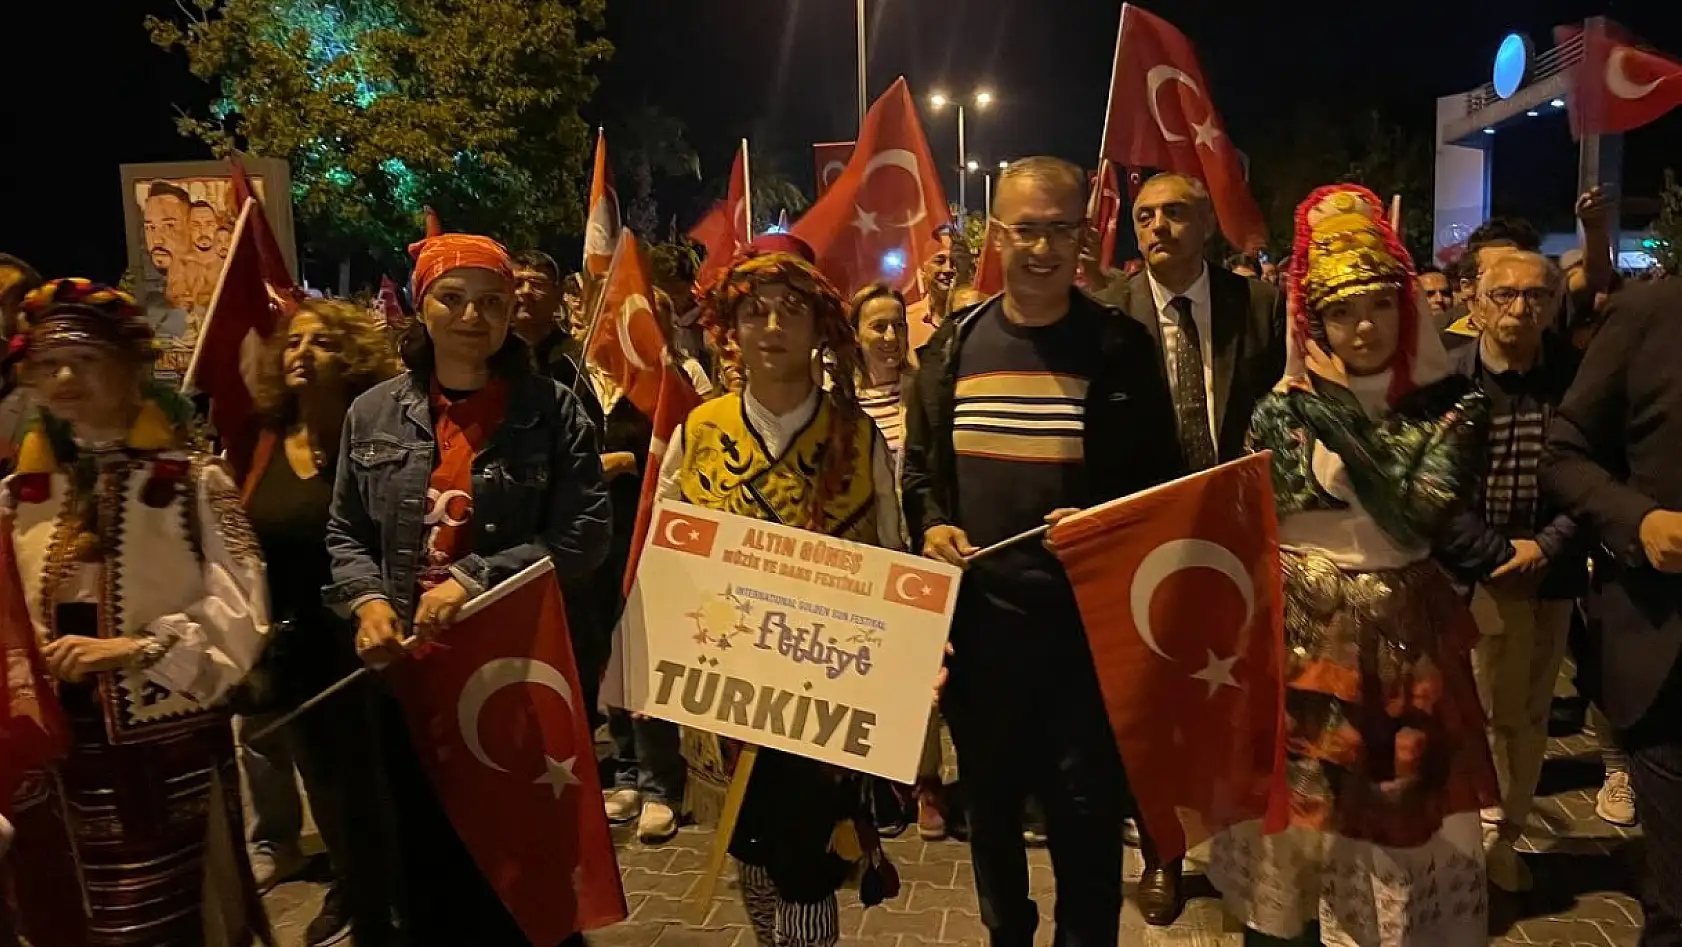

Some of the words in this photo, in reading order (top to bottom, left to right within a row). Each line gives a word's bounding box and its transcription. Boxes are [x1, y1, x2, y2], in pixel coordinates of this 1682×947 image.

[722, 550, 761, 570] MÜZİK
[763, 559, 779, 574] VE
[743, 528, 796, 557] ALTIN
[800, 540, 863, 573] GÜNEŞ
[735, 586, 796, 608] INTERNATIONAL
[798, 601, 830, 616] GOLDEN
[832, 609, 848, 621] SUN
[850, 613, 885, 630] FESTIVAL
[754, 611, 873, 679] Fethiye
[655, 654, 876, 758] TÜRKİYE
